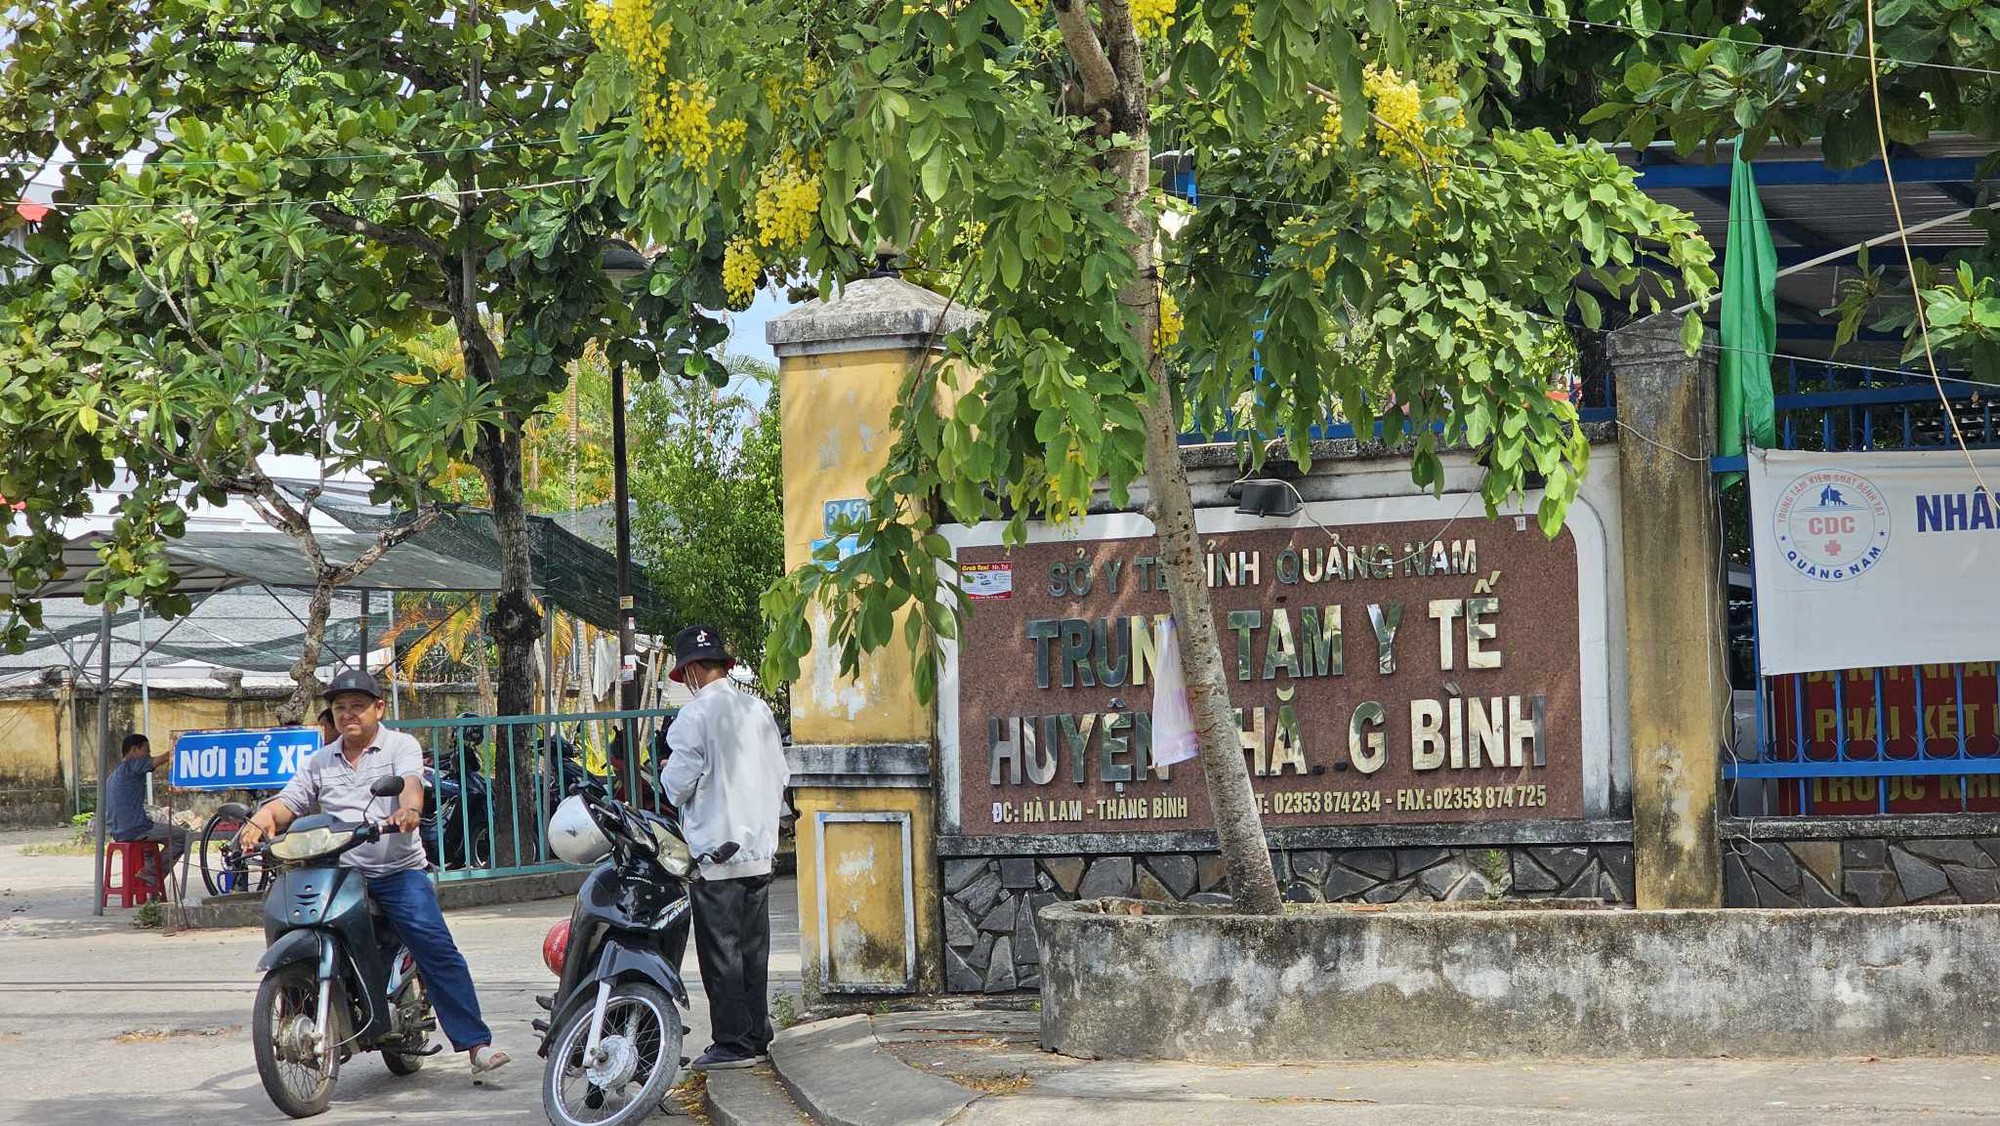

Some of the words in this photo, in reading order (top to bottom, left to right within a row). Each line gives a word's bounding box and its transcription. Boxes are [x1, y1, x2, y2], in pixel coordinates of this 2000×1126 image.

[1808, 516, 1856, 535] CDC
[1916, 485, 2000, 532] NHÂ
[1048, 547, 1094, 597] SỞ
[1103, 556, 1123, 595] Y
[1206, 539, 1260, 588] ỈNH
[1404, 539, 1477, 577] NAM
[1787, 550, 1843, 579] QUẢNG
[1849, 546, 1881, 575] NAM
[1026, 613, 1176, 689] TRUN
[1366, 600, 1406, 675] Y
[1428, 570, 1501, 671] TẾ
[1410, 679, 1547, 771] BÌNH
[179, 745, 227, 779] NƠI
[234, 734, 272, 777] ĐỂ
[1023, 797, 1045, 823] HÀ
[1049, 800, 1082, 822] LAM
[1097, 794, 1148, 820] THĂNG
[1152, 792, 1188, 819] BÌNH
[1255, 793, 1270, 814] T:
